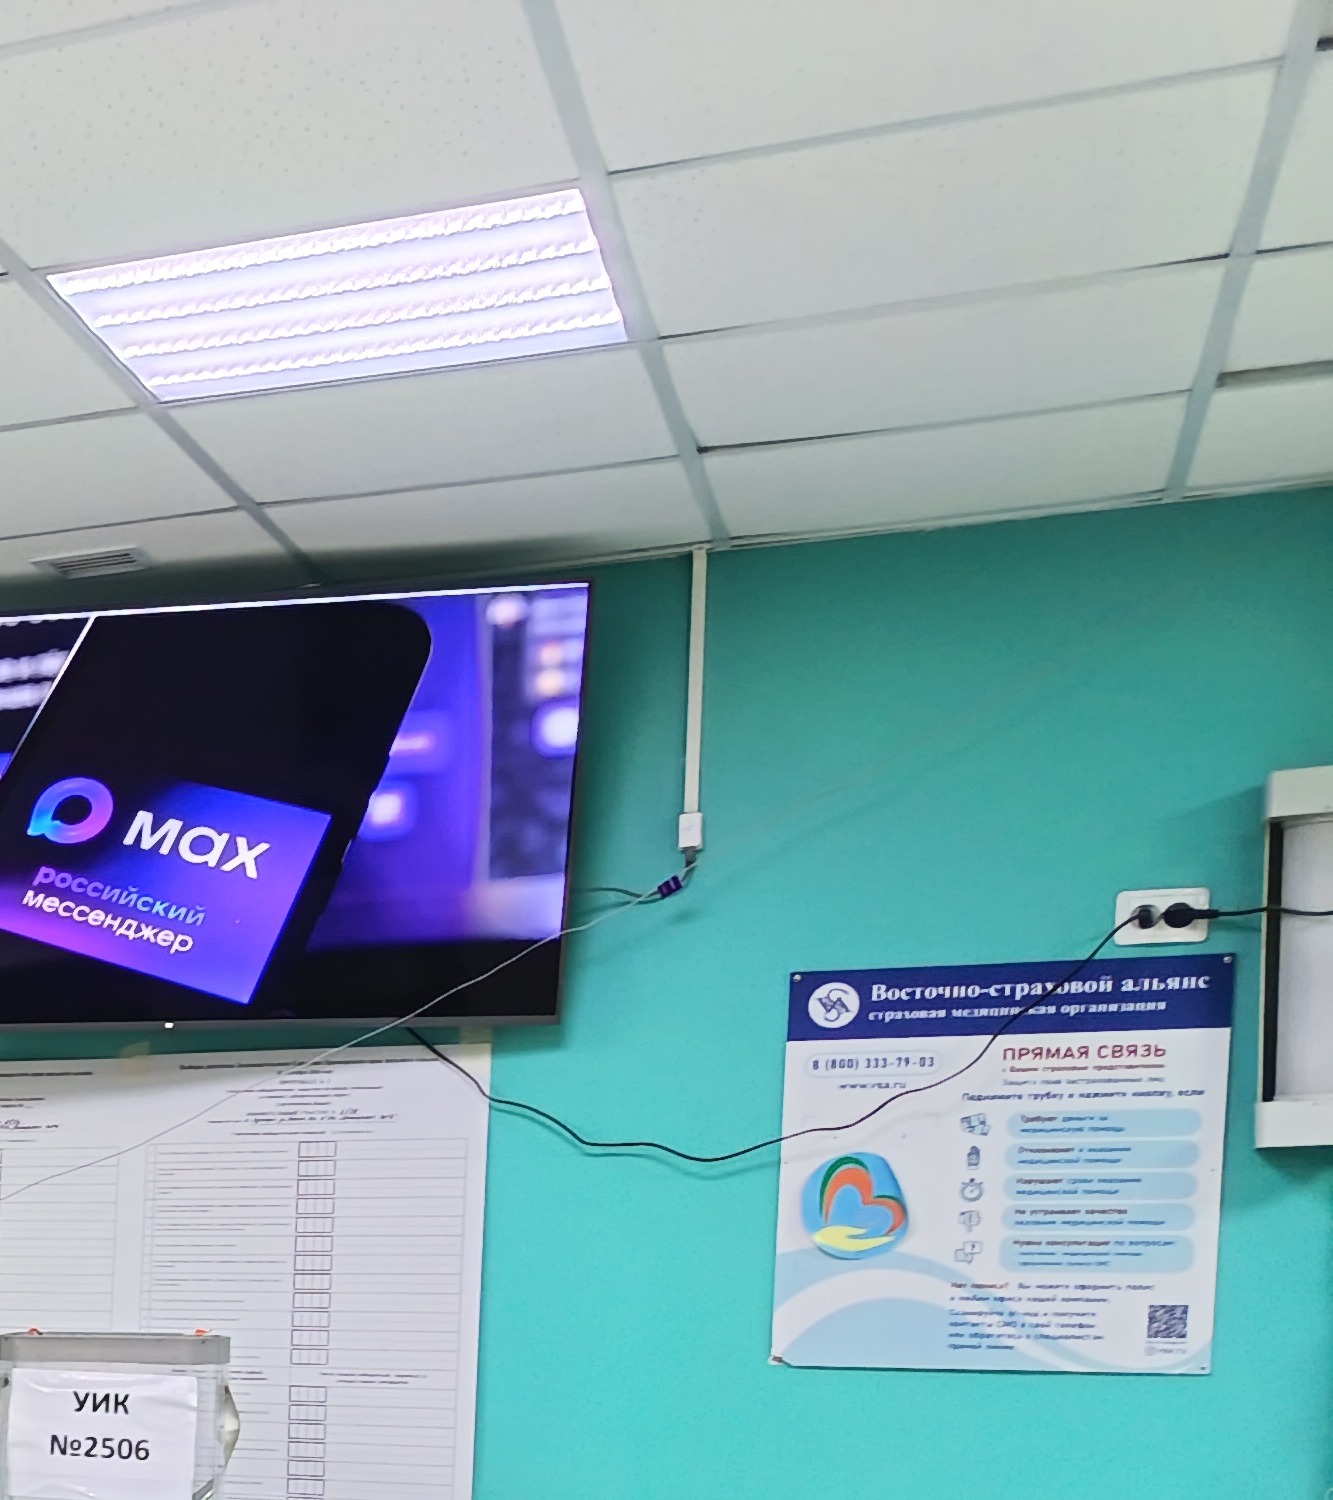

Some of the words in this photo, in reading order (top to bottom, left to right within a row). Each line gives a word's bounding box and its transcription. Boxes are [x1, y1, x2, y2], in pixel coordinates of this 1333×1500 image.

[33, 865, 206, 927] российский
[22, 890, 194, 954] мессенджер
[1121, 973, 1211, 992] альянс
[1003, 1046, 1089, 1061] ПРЯМАЯ
[1097, 1044, 1167, 1059] СВЯЗЬ
[73, 1390, 130, 1415] УИК
[50, 1434, 150, 1460] №2506
